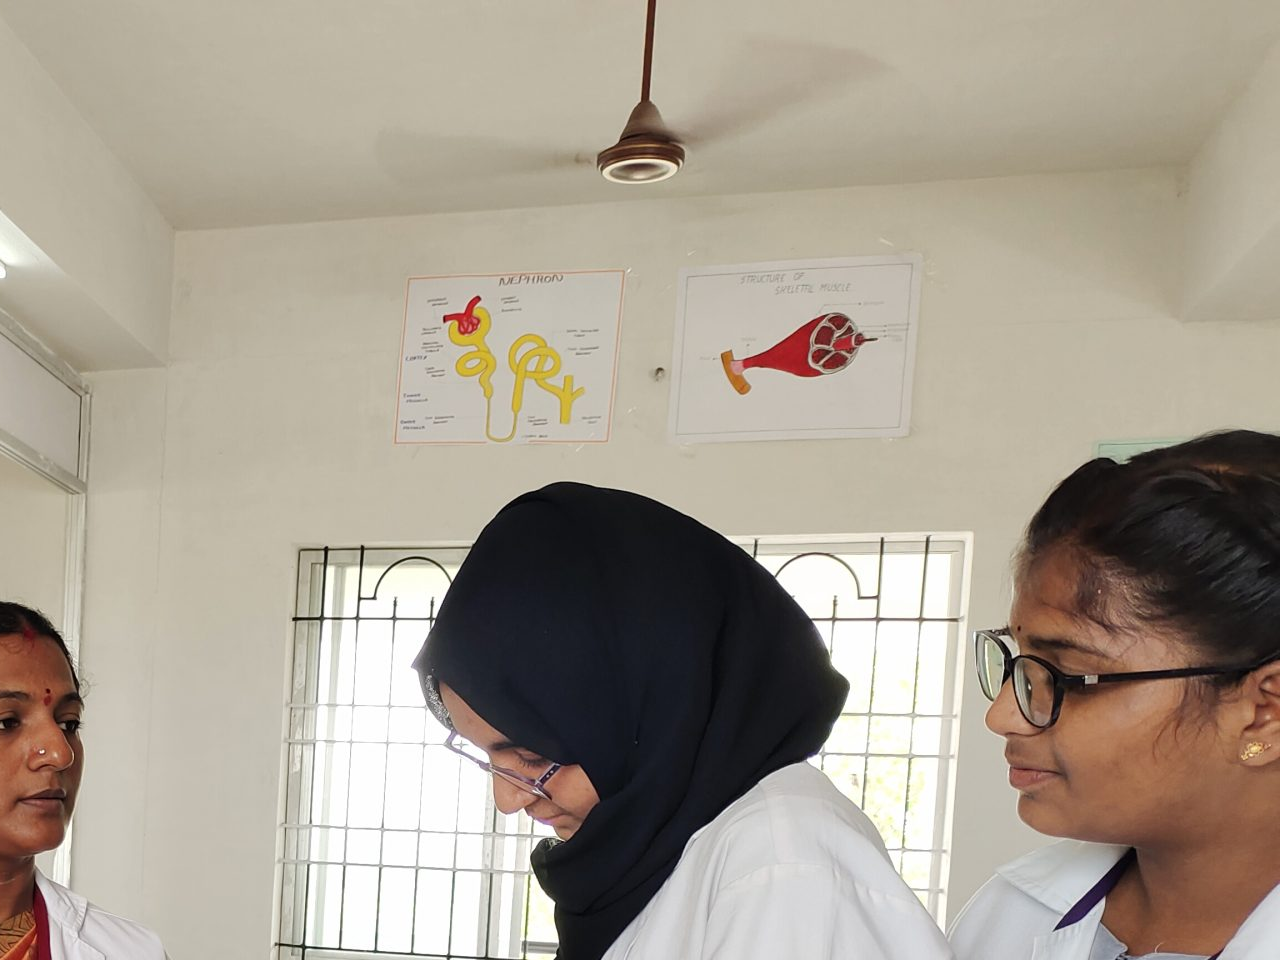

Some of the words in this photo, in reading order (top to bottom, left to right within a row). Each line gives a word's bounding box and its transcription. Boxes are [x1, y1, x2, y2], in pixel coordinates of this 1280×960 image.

[498, 274, 564, 287] NEPHRON
[740, 273, 786, 285] STRUCTURE
[792, 271, 806, 282] OF
[820, 282, 852, 293] MUSCLE
